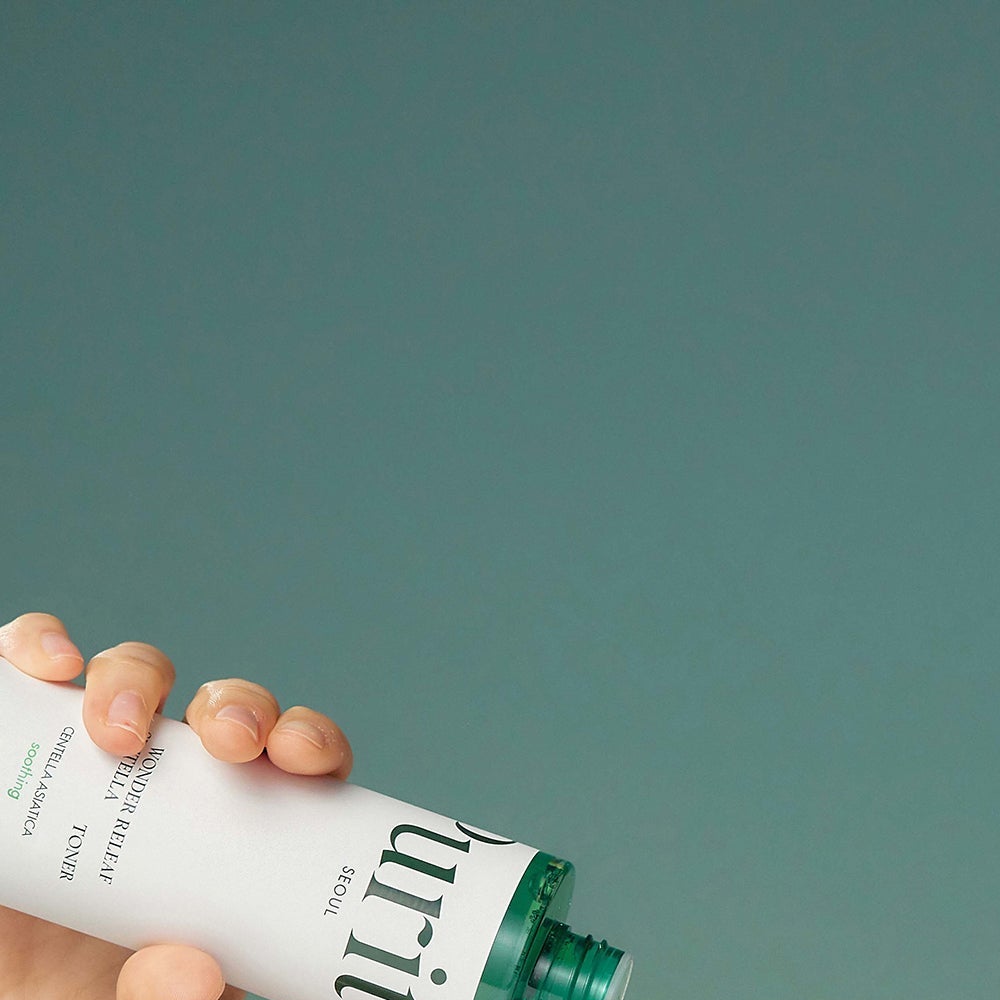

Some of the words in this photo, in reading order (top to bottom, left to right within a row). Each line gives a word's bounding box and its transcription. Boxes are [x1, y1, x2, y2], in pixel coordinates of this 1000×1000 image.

[7, 742, 40, 800] soothing
[41, 726, 75, 779] CENTELLA
[104, 731, 152, 801] TELLA
[120, 747, 165, 814] WONDER
[21, 781, 48, 837] ASIATICA
[59, 824, 88, 881] TONER
[98, 818, 130, 885] RELEAF
[323, 865, 355, 916] SEOUL
